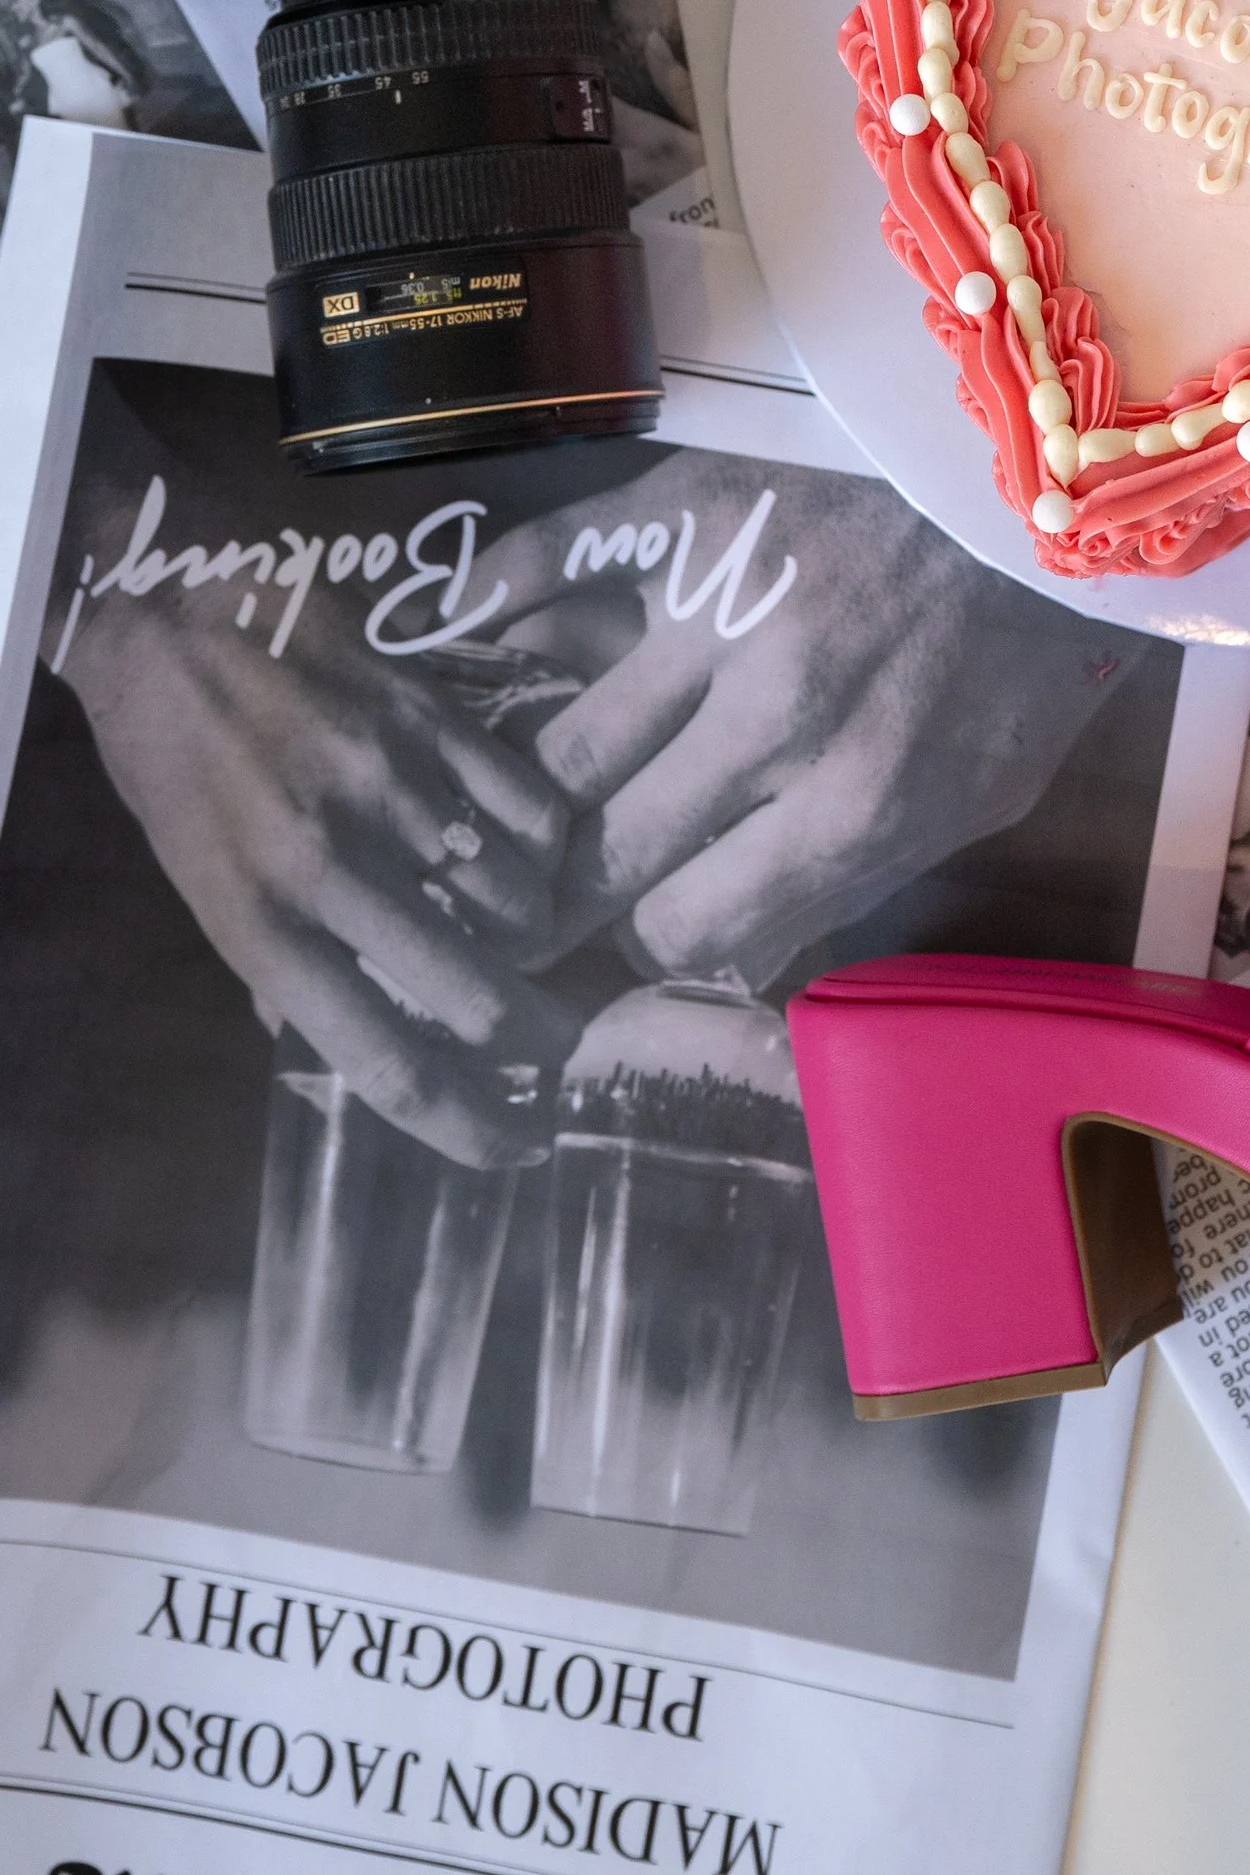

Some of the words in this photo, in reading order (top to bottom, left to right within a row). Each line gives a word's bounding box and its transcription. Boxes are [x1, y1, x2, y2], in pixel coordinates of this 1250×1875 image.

[375, 76, 392, 91] 45
[412, 71, 429, 85] 55
[469, 272, 522, 291] Nikon
[328, 296, 355, 315] DX
[497, 305, 524, 319] AF-S
[446, 309, 493, 325] NIKKOR
[322, 330, 351, 346] ED
[51, 476, 508, 673] Booking!
[565, 490, 797, 640] Now
[1197, 1326, 1223, 1348] in
[1208, 1351, 1224, 1368] a
[137, 1575, 714, 1741] PHOTOGRAPHY
[39, 1687, 419, 1817] JACOBSON
[436, 1758, 784, 1875] MADISON
